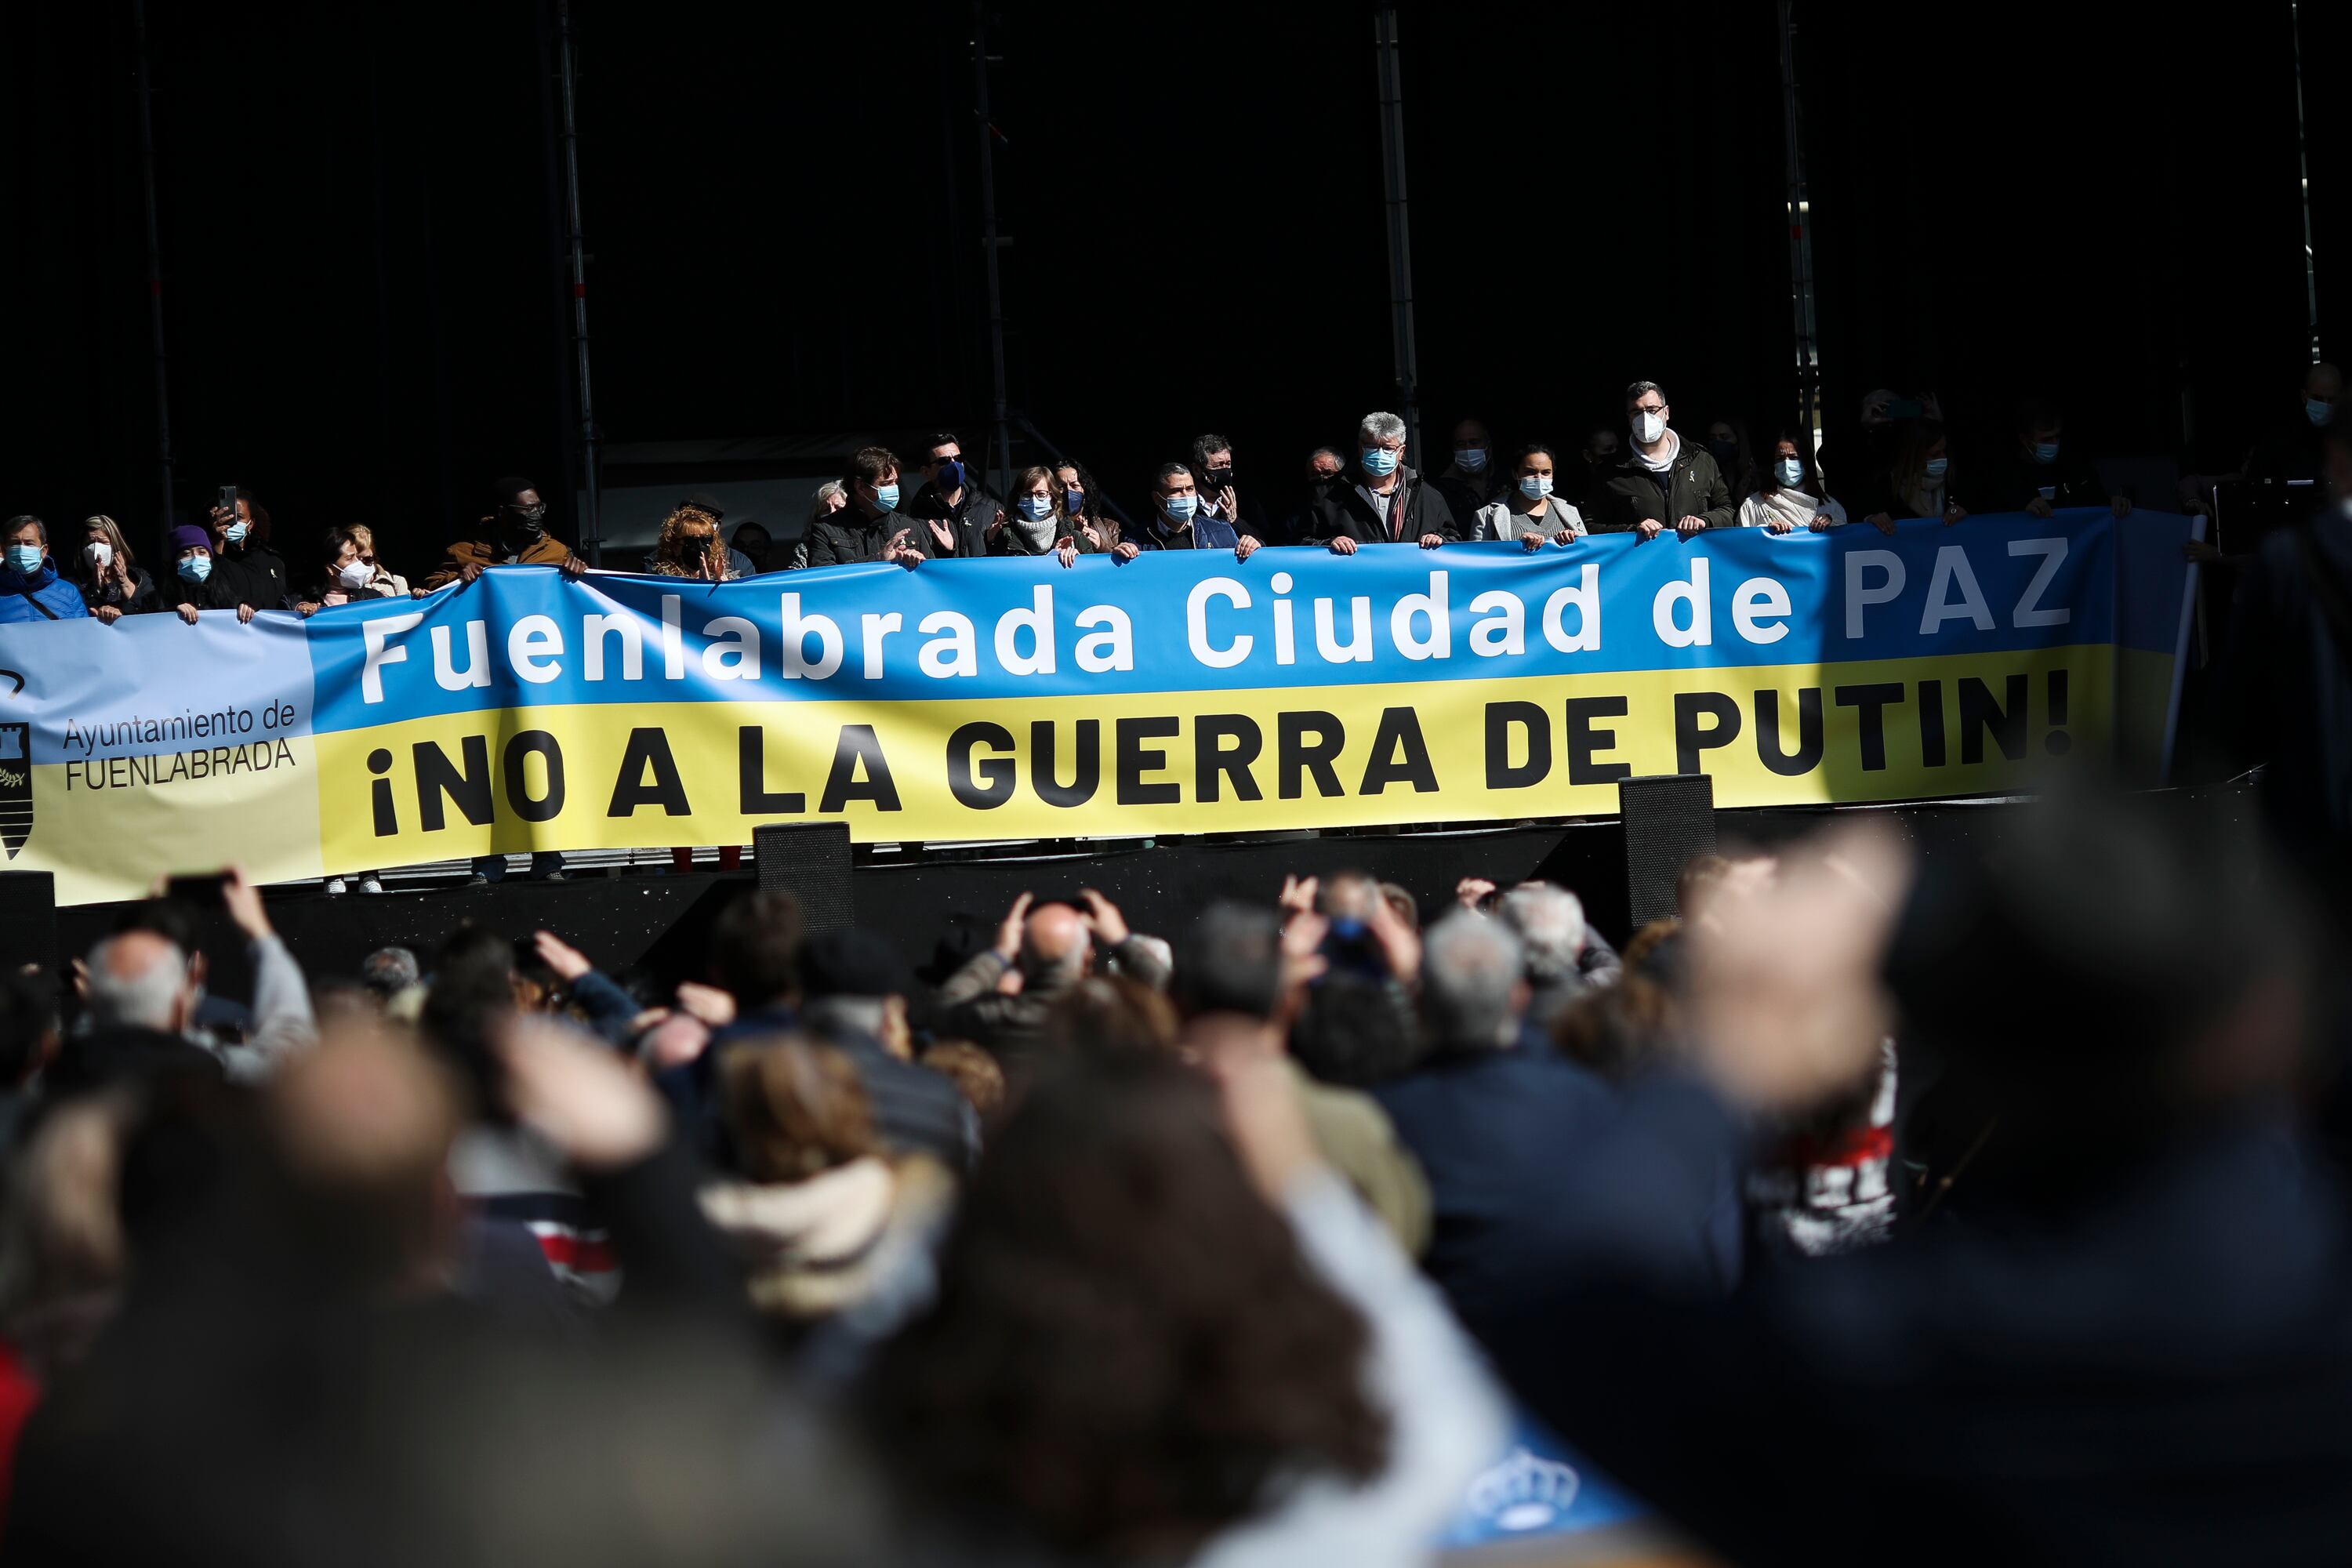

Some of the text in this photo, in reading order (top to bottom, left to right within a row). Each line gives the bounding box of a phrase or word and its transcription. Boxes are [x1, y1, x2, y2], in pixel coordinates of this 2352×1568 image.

[361, 537, 2071, 704] Fuenlabrada Ciudad de PAZ
[63, 699, 296, 757] Ayuntamiento de
[66, 737, 296, 791] FUENLABRADA
[367, 669, 2072, 837] ¡NO A LA GUERRA DE PUTIN!
